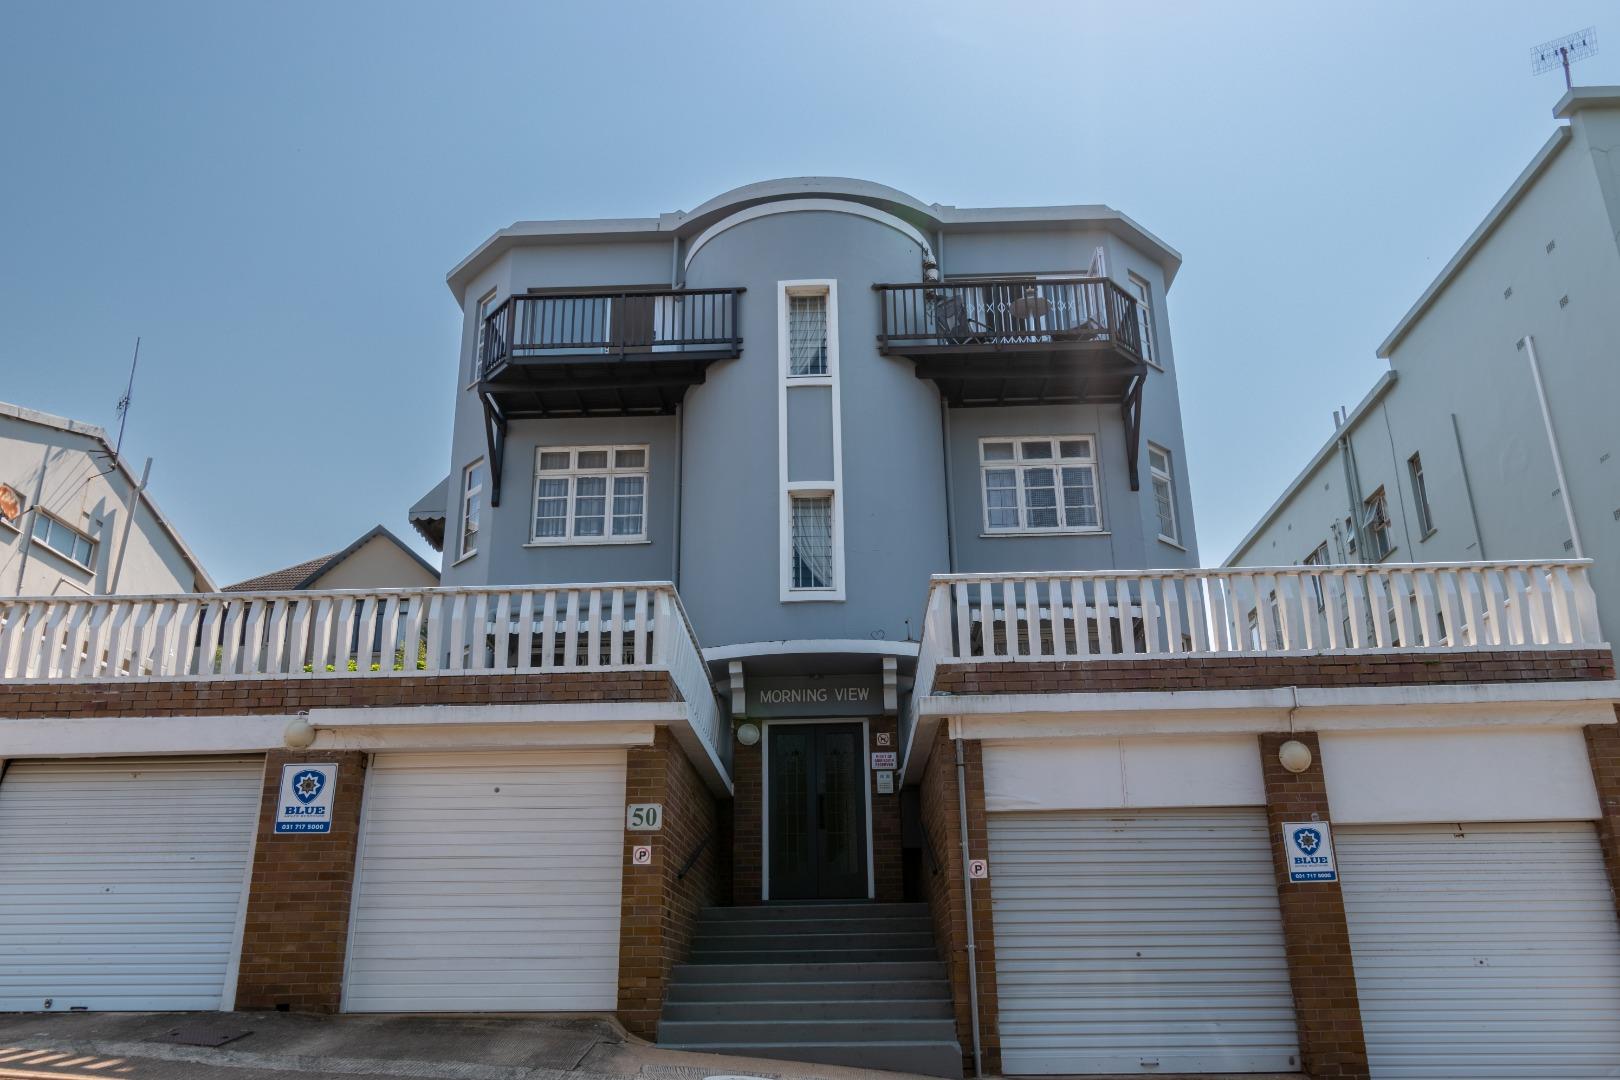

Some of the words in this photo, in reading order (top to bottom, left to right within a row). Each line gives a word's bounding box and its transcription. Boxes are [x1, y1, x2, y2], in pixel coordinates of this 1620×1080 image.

[760, 689, 828, 703] MORNING
[834, 687, 869, 702] VIEW
[285, 806, 326, 815] BLUE
[631, 807, 657, 827] 50
